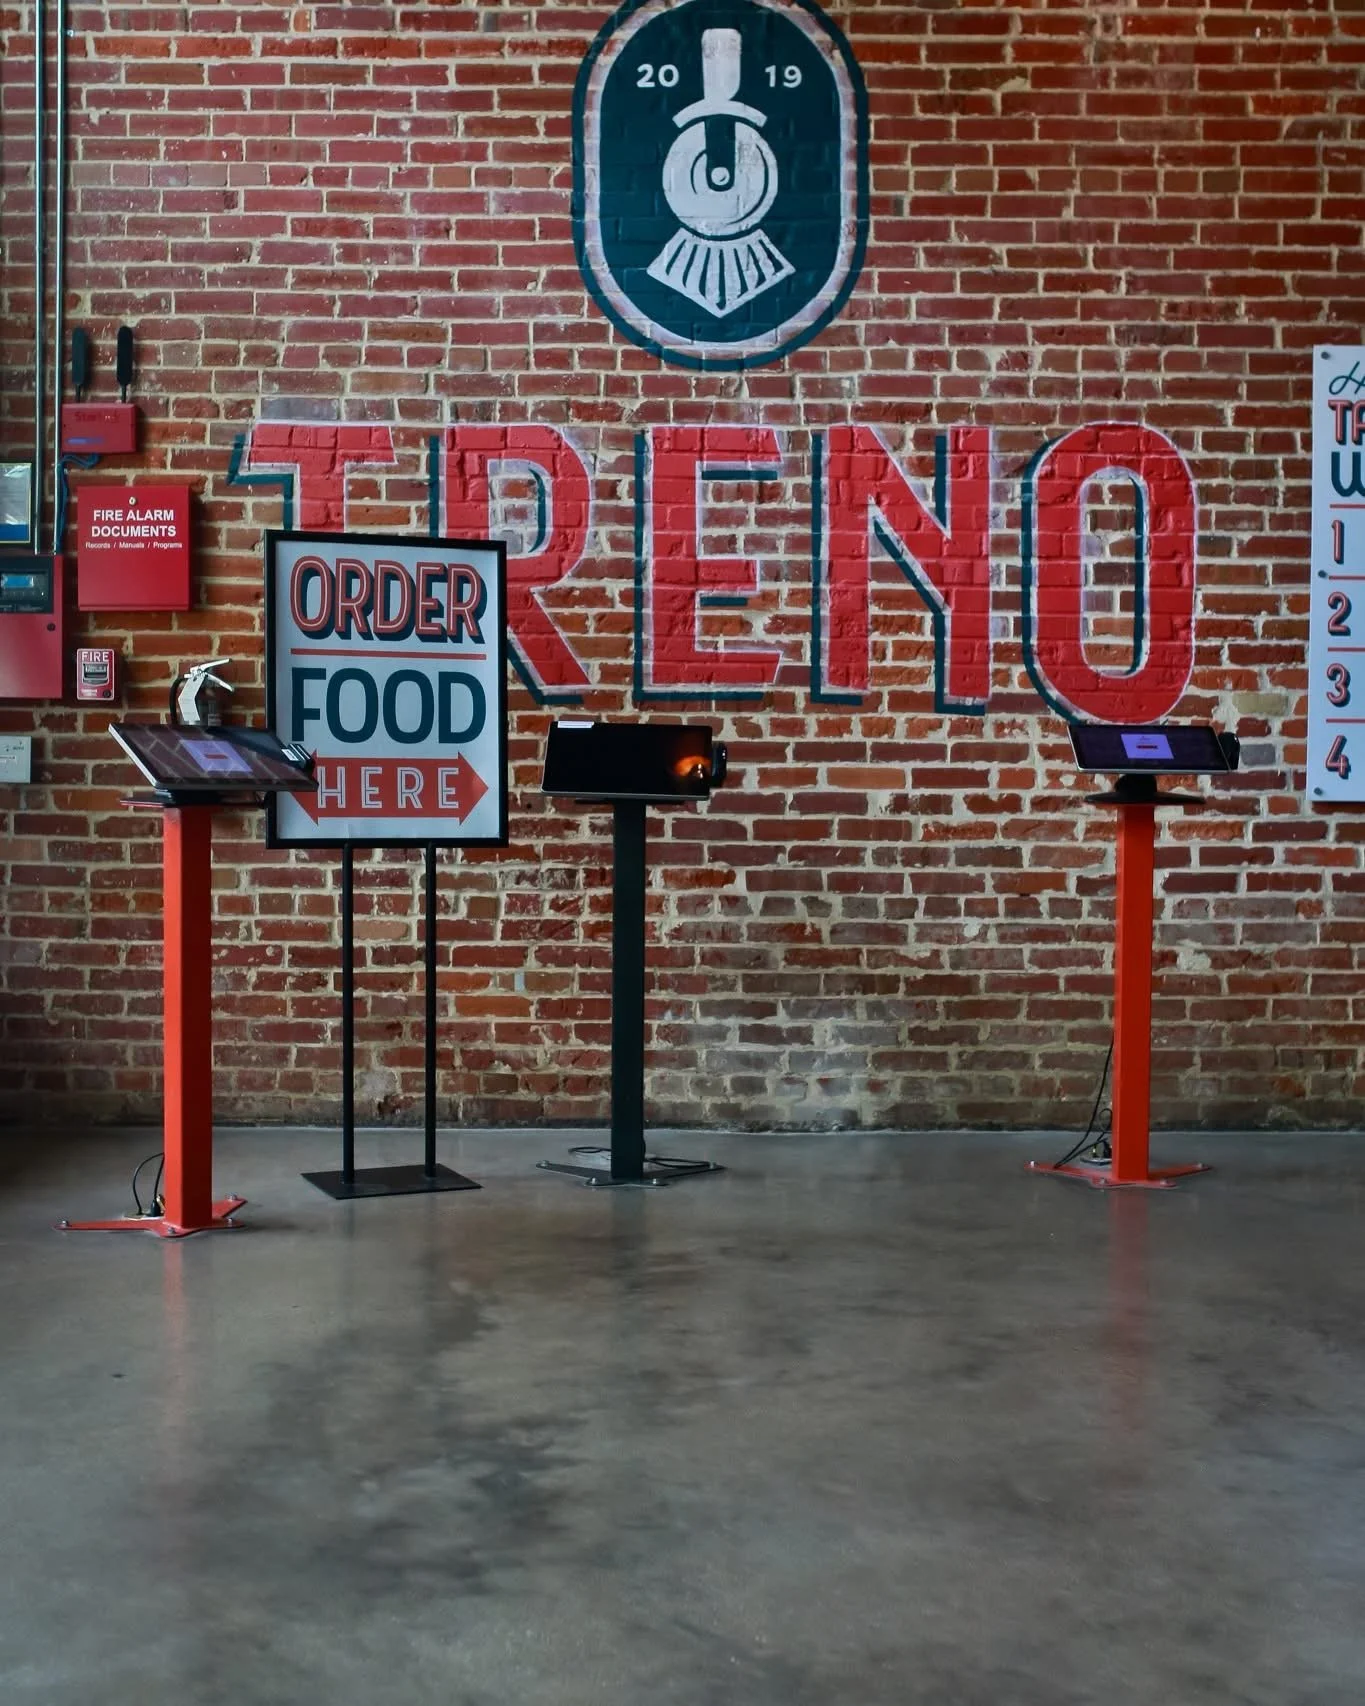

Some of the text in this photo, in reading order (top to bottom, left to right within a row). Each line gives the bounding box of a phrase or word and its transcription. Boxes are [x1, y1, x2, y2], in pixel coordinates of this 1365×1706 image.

[636, 63, 803, 88] 20 19
[91, 525, 177, 537] DOCUMENTS
[93, 509, 174, 521] FIRE ALARM
[85, 541, 111, 549] Records
[119, 541, 145, 549] Manuals
[153, 541, 183, 550] Programs
[1331, 519, 1345, 565] 1
[229, 419, 1201, 726] TRENO
[290, 555, 488, 645] ORDER
[1327, 591, 1352, 636] 2
[81, 651, 110, 662] FIRE
[291, 666, 487, 744] FOOD
[1326, 662, 1351, 708] 3
[1324, 734, 1351, 780] 4
[317, 766, 460, 809] HERE
